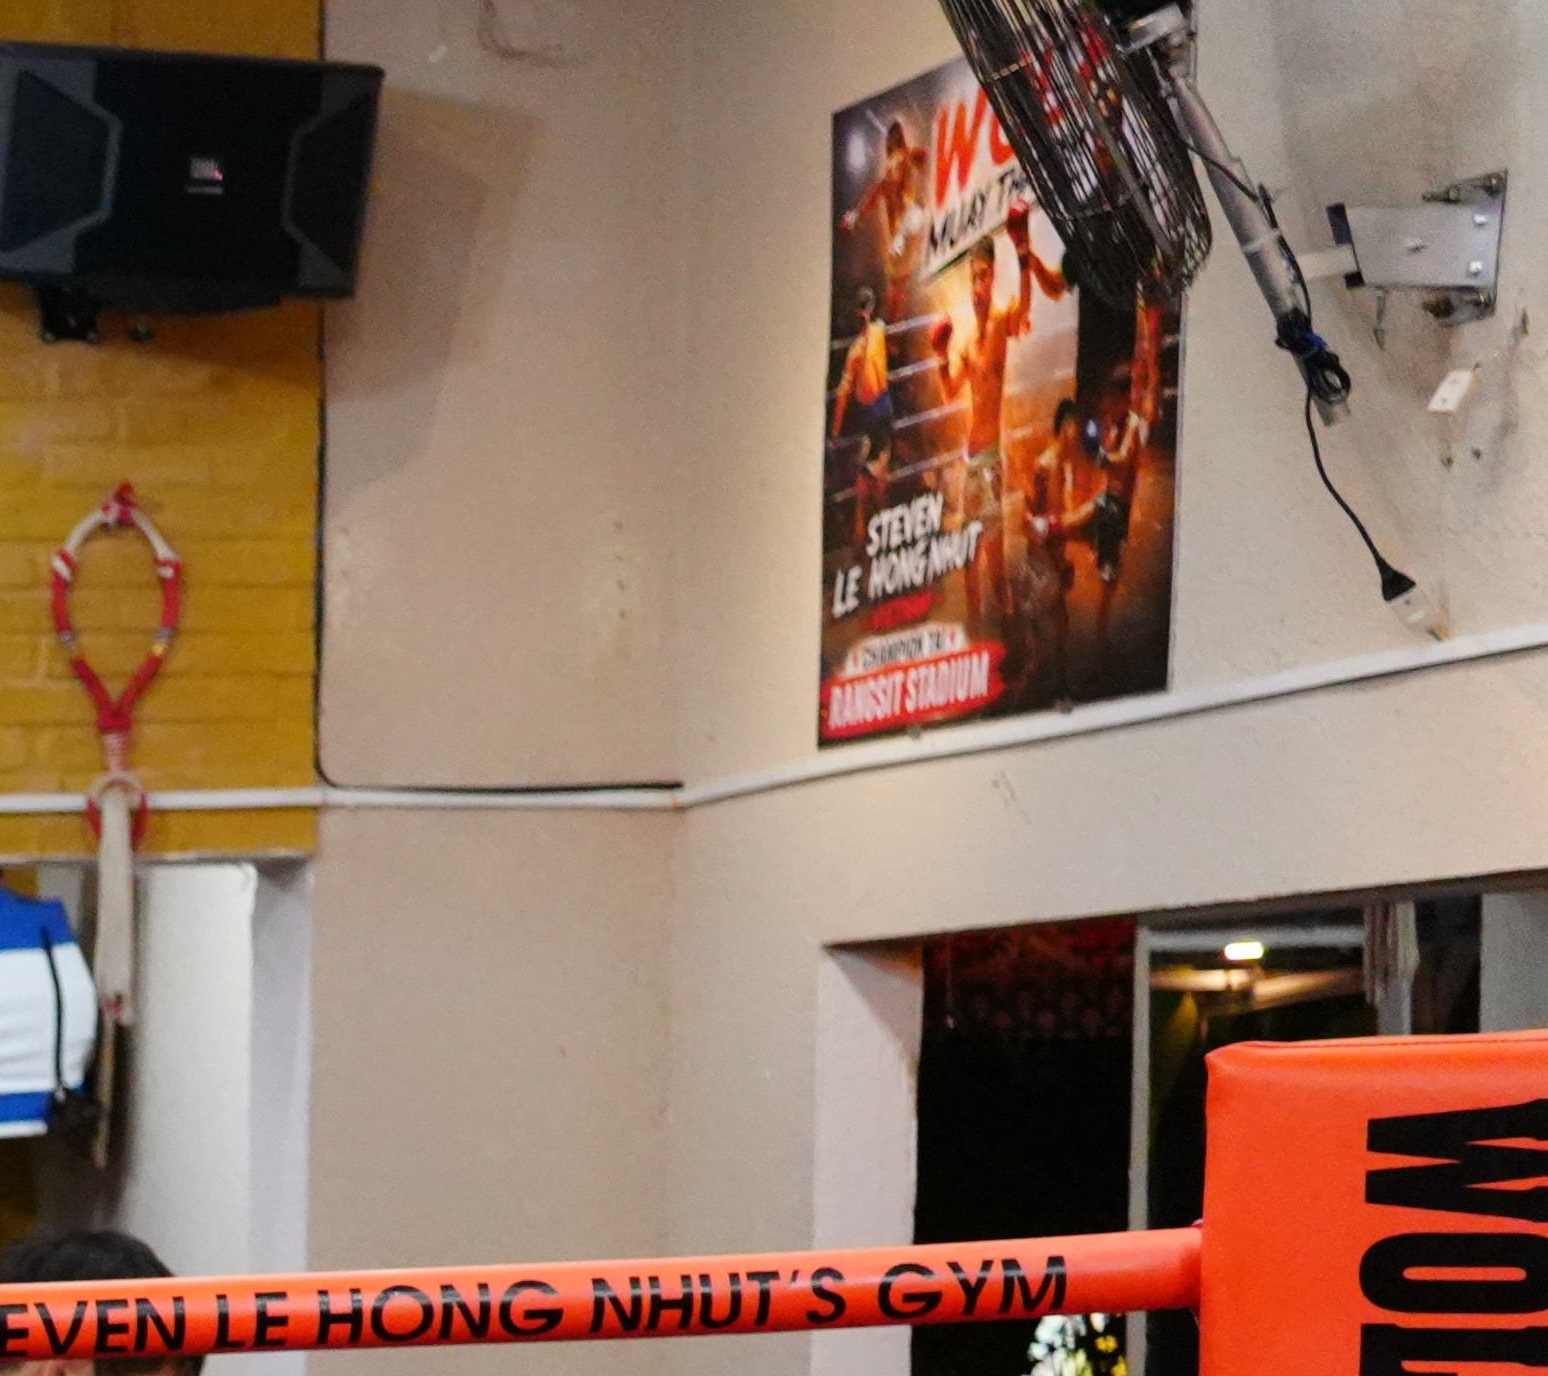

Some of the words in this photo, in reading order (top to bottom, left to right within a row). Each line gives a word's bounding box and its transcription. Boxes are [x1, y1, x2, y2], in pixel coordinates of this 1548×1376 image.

[865, 490, 945, 558] STEVEN
[831, 563, 863, 619] LE
[215, 1289, 290, 1352] LE
[315, 1279, 564, 1346] HONG
[589, 1266, 848, 1337] NHUT'S
[877, 1256, 1070, 1321] GYM
